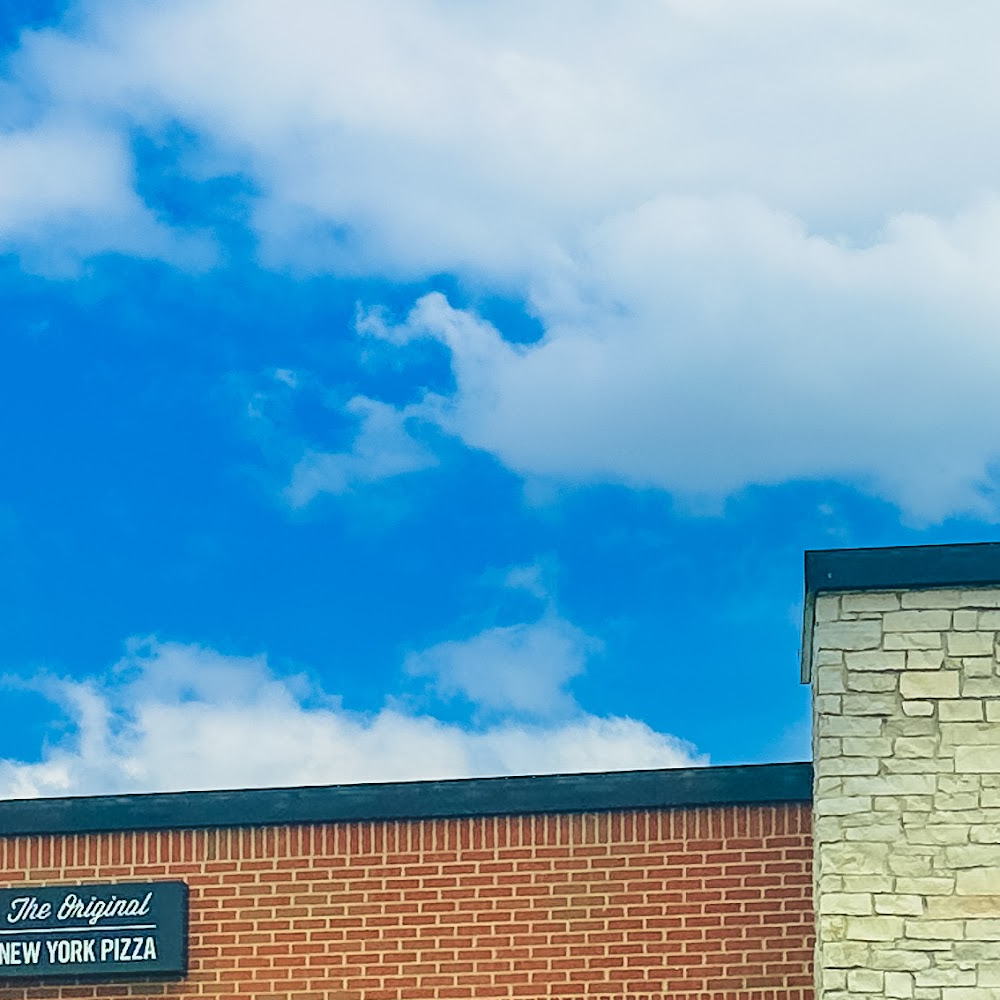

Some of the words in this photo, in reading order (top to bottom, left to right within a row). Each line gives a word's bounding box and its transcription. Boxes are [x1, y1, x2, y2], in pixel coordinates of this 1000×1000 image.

[7, 896, 52, 924] The
[56, 891, 153, 926] Original
[45, 938, 96, 964] YORK
[100, 936, 157, 962] PIZZA
